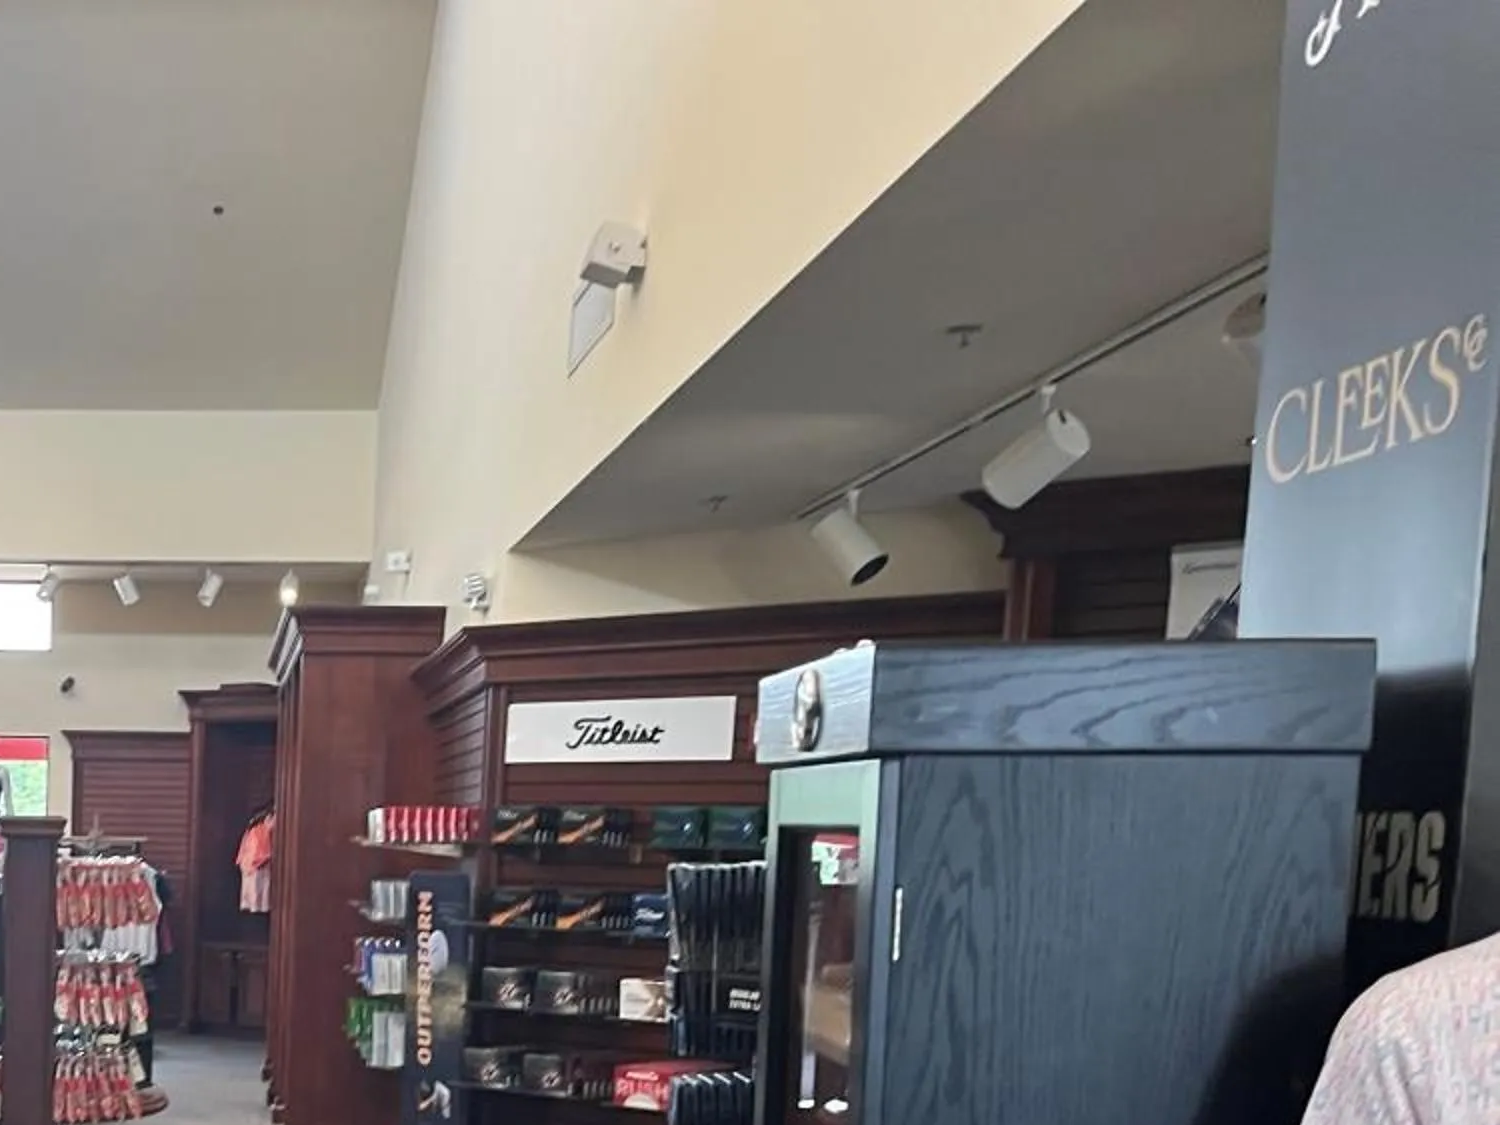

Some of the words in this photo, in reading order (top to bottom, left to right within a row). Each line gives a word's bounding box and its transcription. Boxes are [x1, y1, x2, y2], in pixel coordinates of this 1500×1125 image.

[1266, 326, 1461, 484] CLEEKS
[565, 715, 665, 750] Titleist
[1353, 810, 1445, 923] ERS
